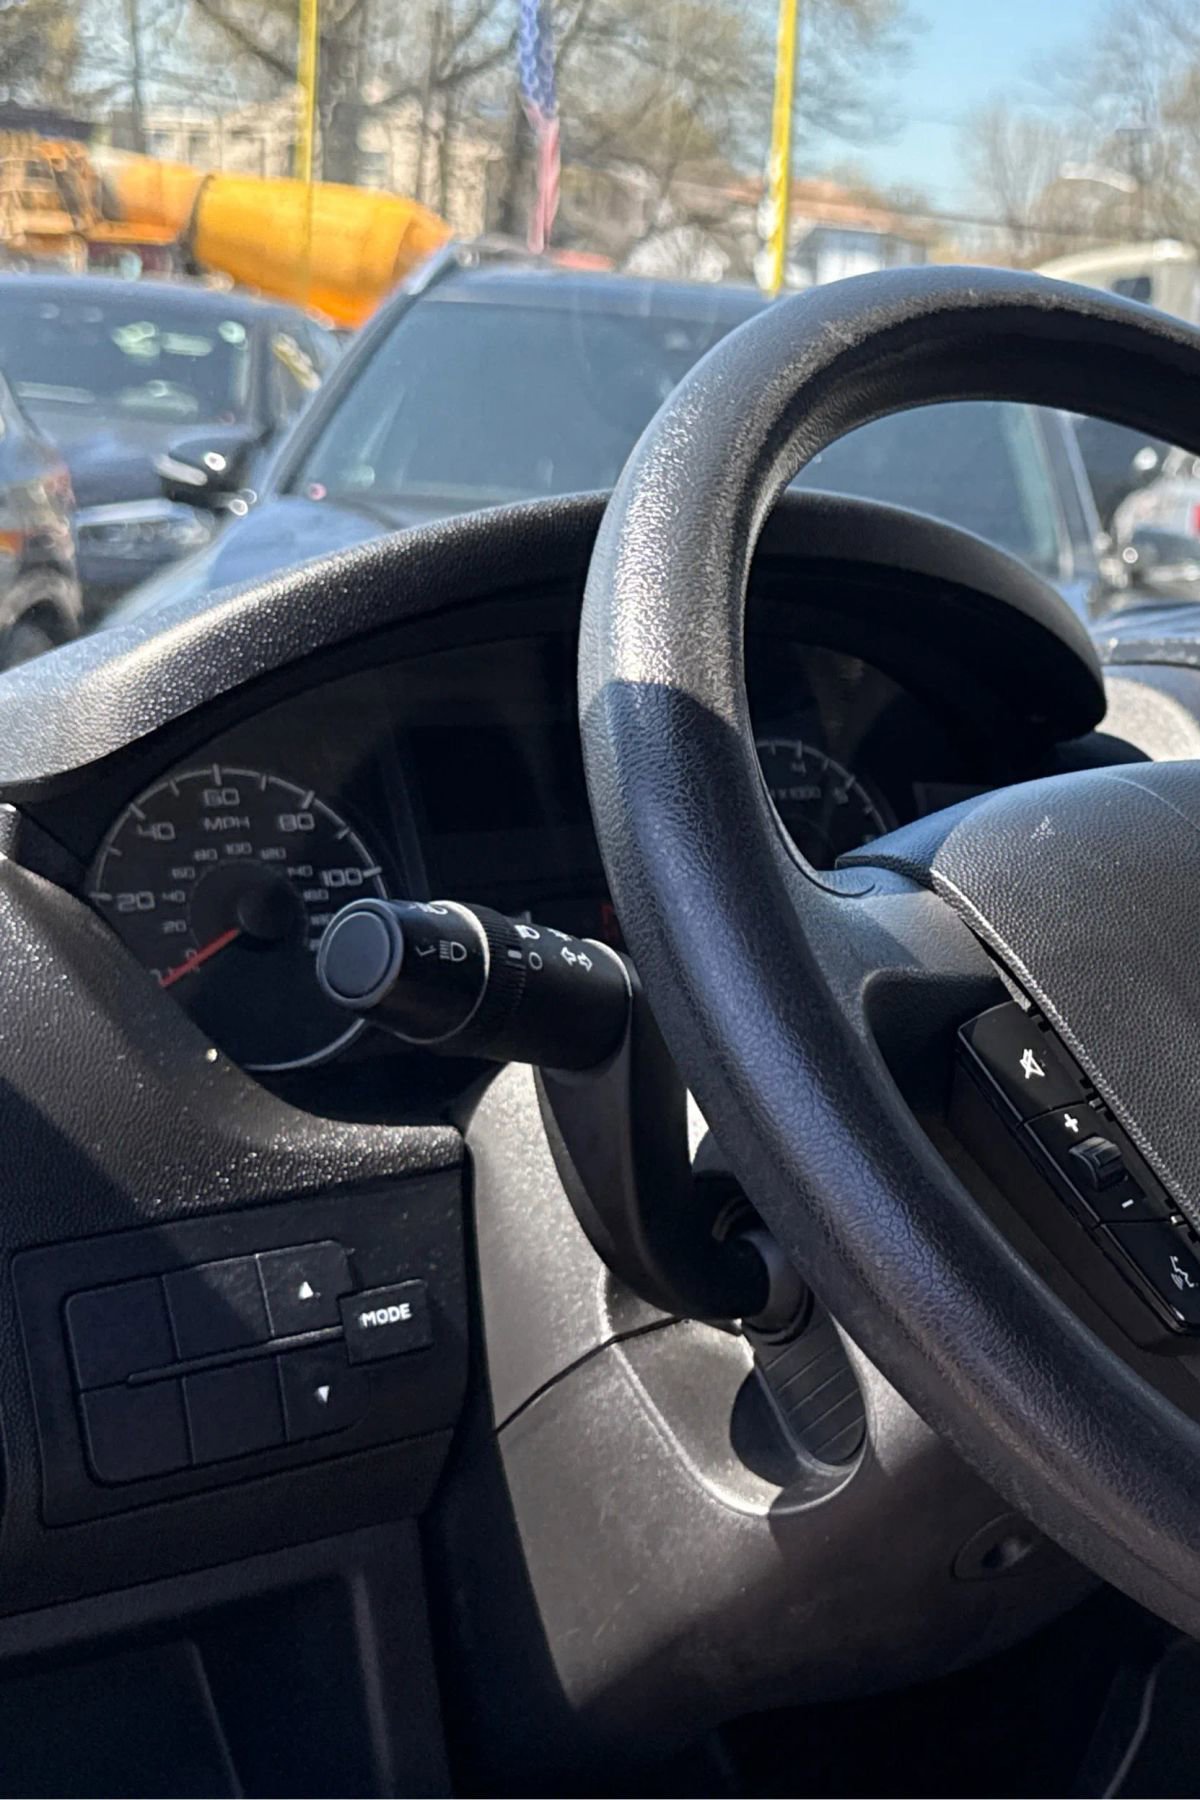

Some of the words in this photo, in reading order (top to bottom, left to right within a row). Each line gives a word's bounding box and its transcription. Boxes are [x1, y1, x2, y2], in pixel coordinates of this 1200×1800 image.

[204, 787, 240, 807] 60
[136, 821, 176, 841] 40
[203, 816, 250, 831] MPH
[279, 813, 315, 832] 80
[321, 868, 363, 887] 100
[116, 891, 155, 912] 20
[360, 1303, 412, 1328] MODE
